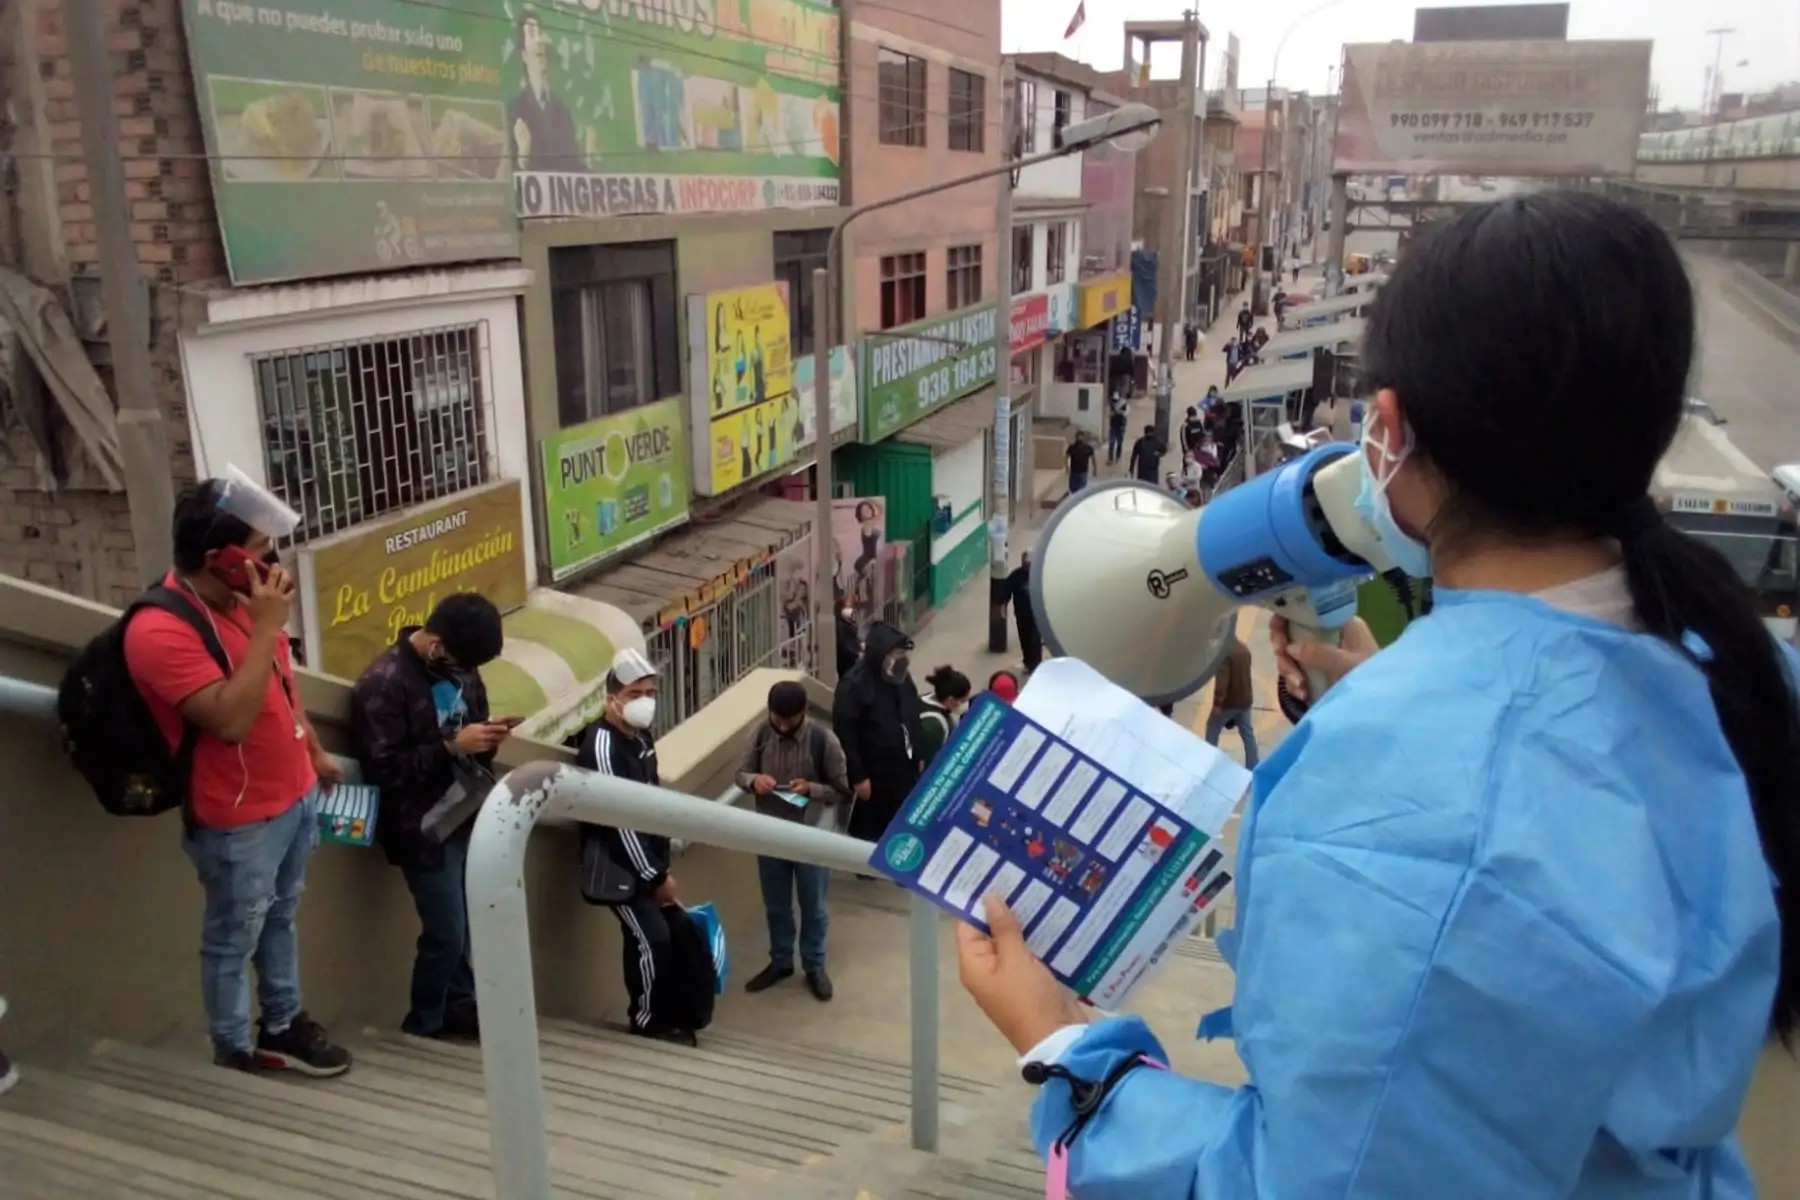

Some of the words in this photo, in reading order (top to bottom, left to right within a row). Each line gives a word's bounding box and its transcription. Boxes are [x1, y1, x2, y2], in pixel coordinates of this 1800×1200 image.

[216, 2, 254, 25] que
[258, 8, 282, 26] no
[286, 10, 348, 34] puedes
[436, 35, 463, 52] uno
[550, 175, 658, 214] INGRESAS
[663, 177, 676, 212] A
[679, 178, 756, 209] INFOCORP
[918, 367, 950, 409] 938
[952, 354, 977, 390] 164
[979, 346, 997, 379] 33
[625, 425, 672, 464] VERDE
[385, 510, 468, 554] RESTAURANT
[331, 584, 371, 627] La
[379, 525, 514, 605] Combinación
